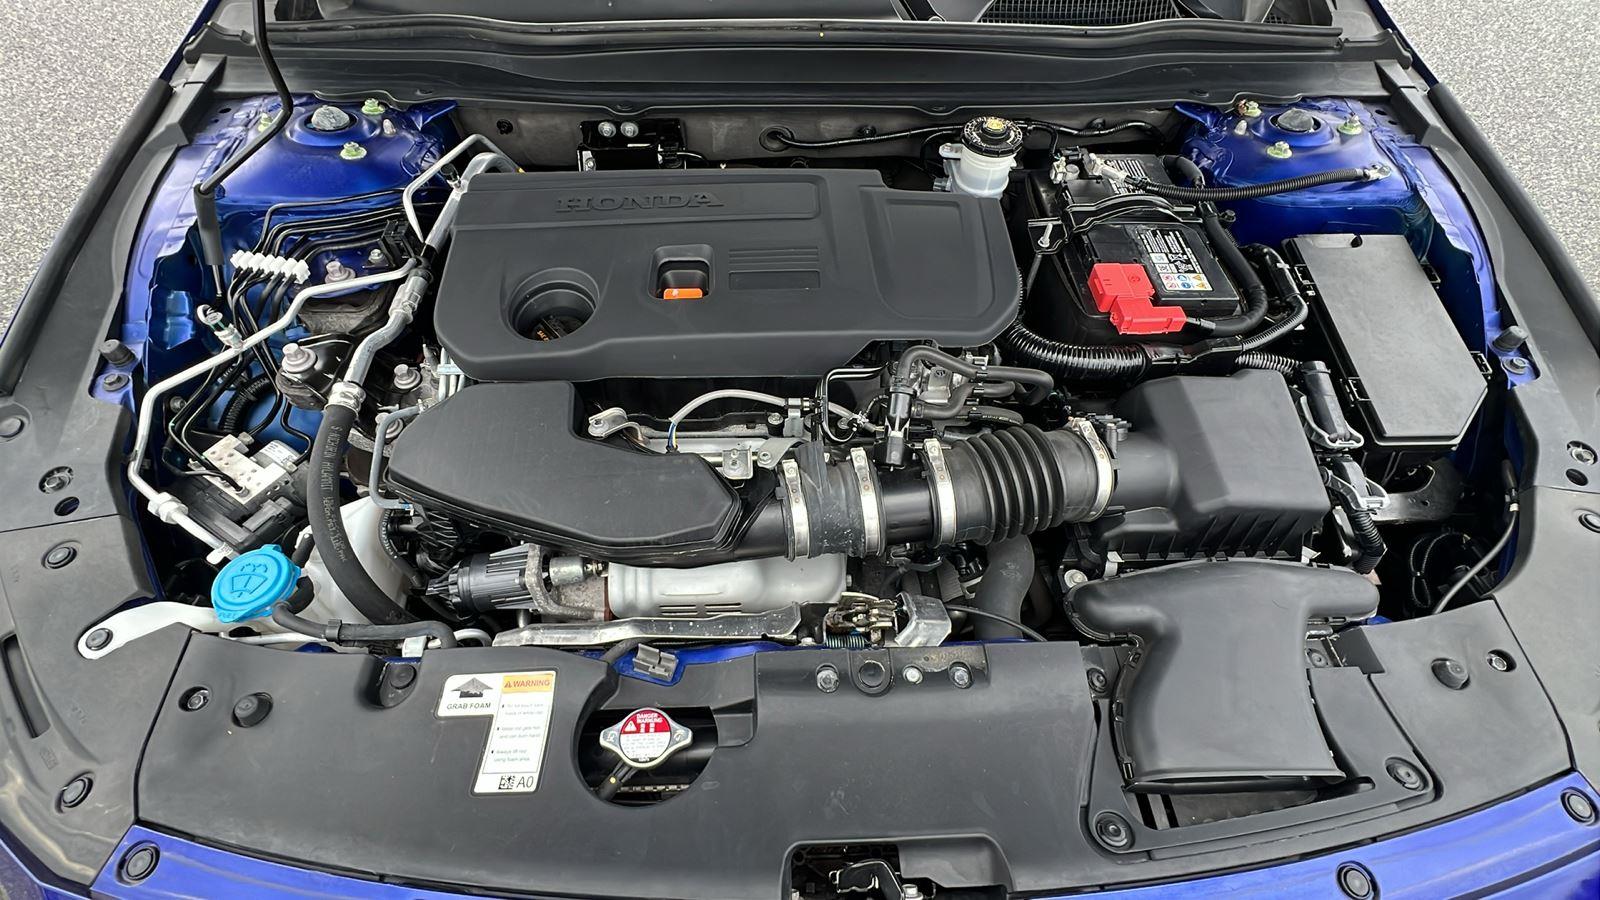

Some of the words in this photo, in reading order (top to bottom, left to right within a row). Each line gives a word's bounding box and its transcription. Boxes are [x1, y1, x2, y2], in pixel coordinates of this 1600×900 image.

[555, 192, 725, 213] HONDA
[511, 679, 551, 688] WARNING
[446, 702, 468, 710] GRAB
[516, 775, 534, 788] A0
